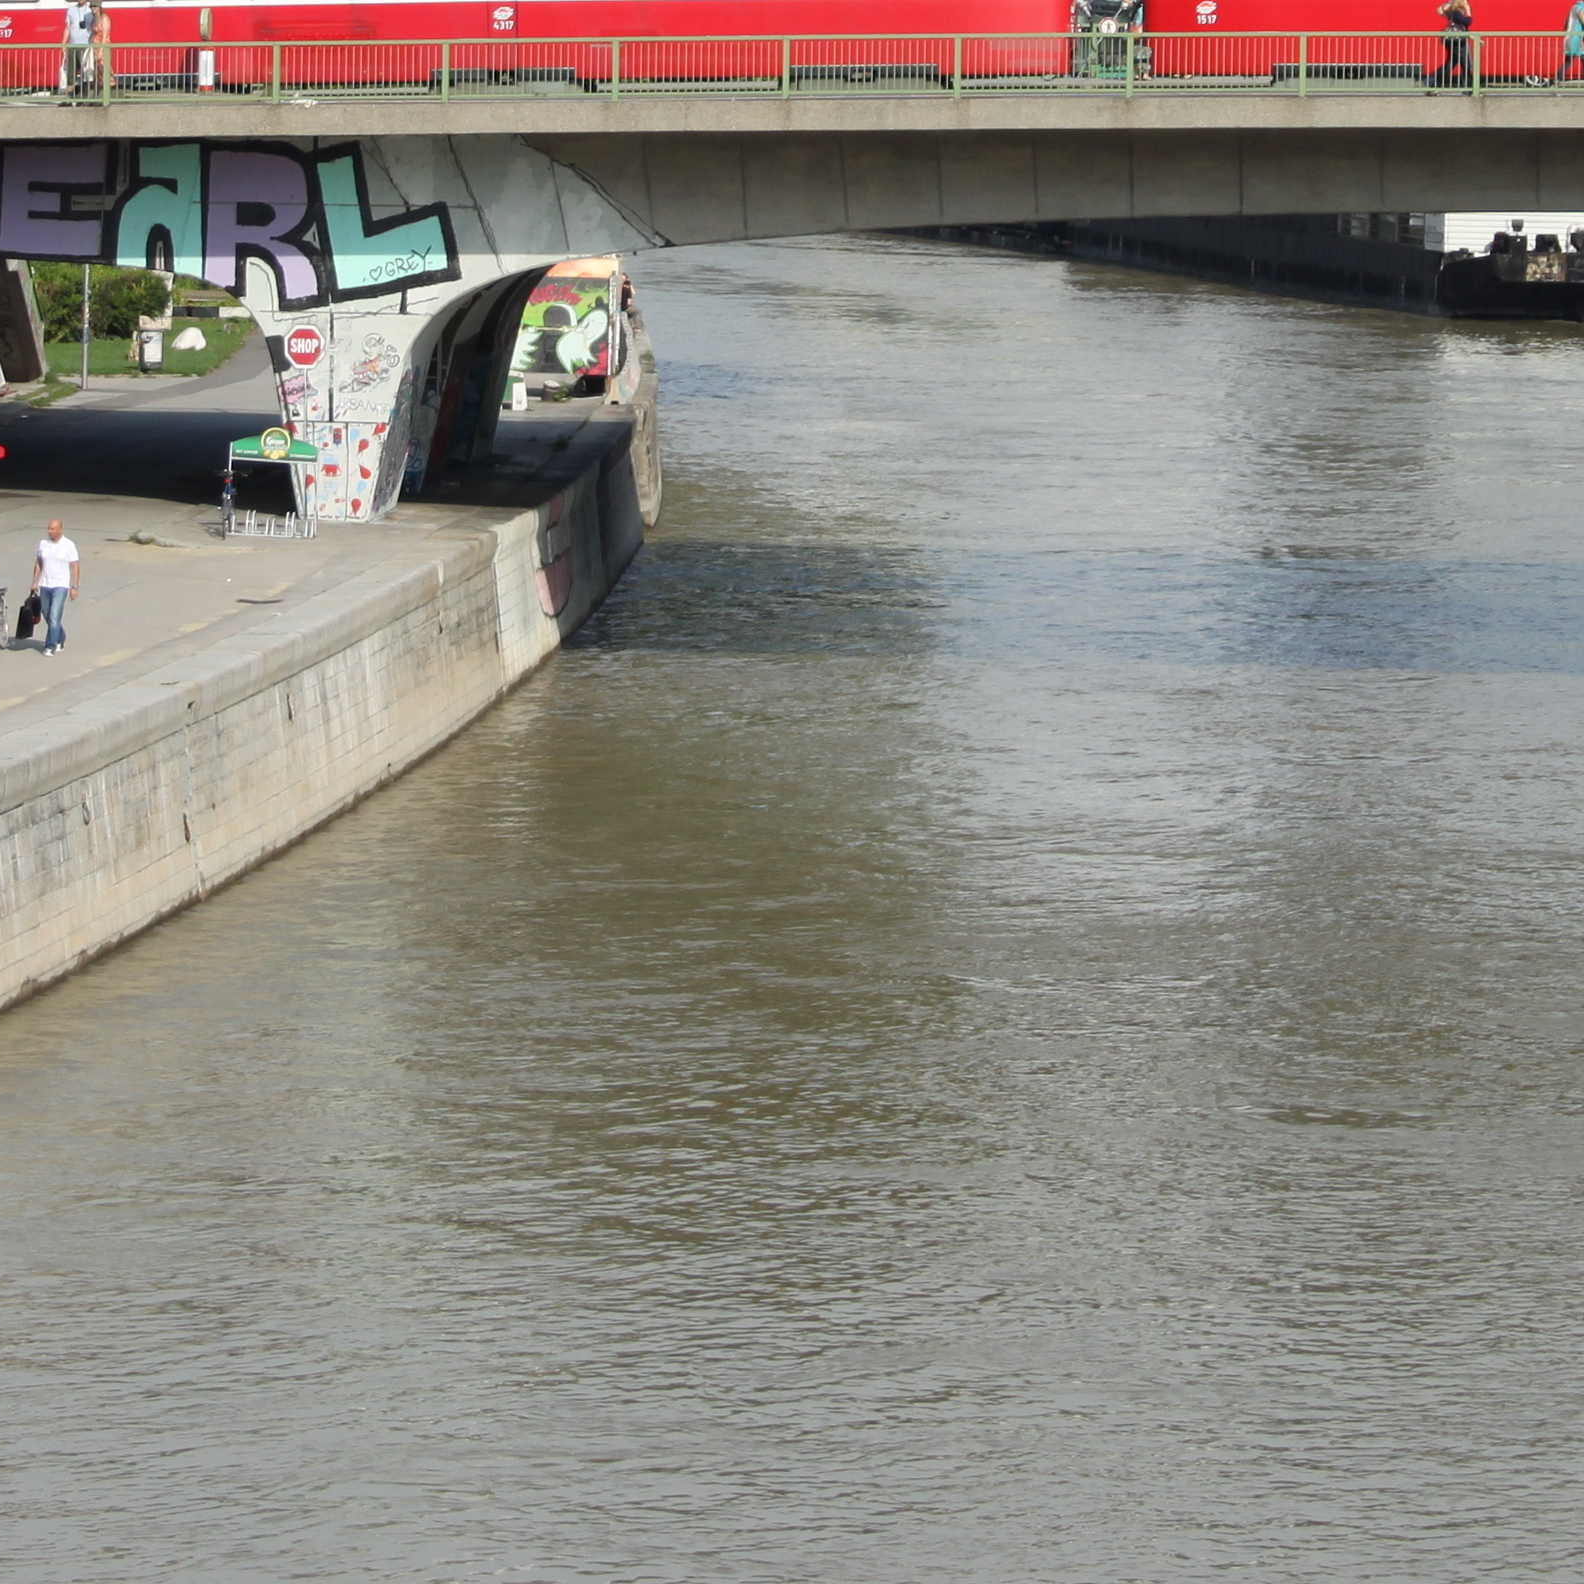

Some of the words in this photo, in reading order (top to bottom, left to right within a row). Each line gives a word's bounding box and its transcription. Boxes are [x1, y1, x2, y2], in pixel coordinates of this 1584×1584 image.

[493, 20, 515, 31] 4317
[1196, 14, 1218, 25] 1517
[384, 245, 433, 279] GREY
[290, 337, 319, 354] SHOP
